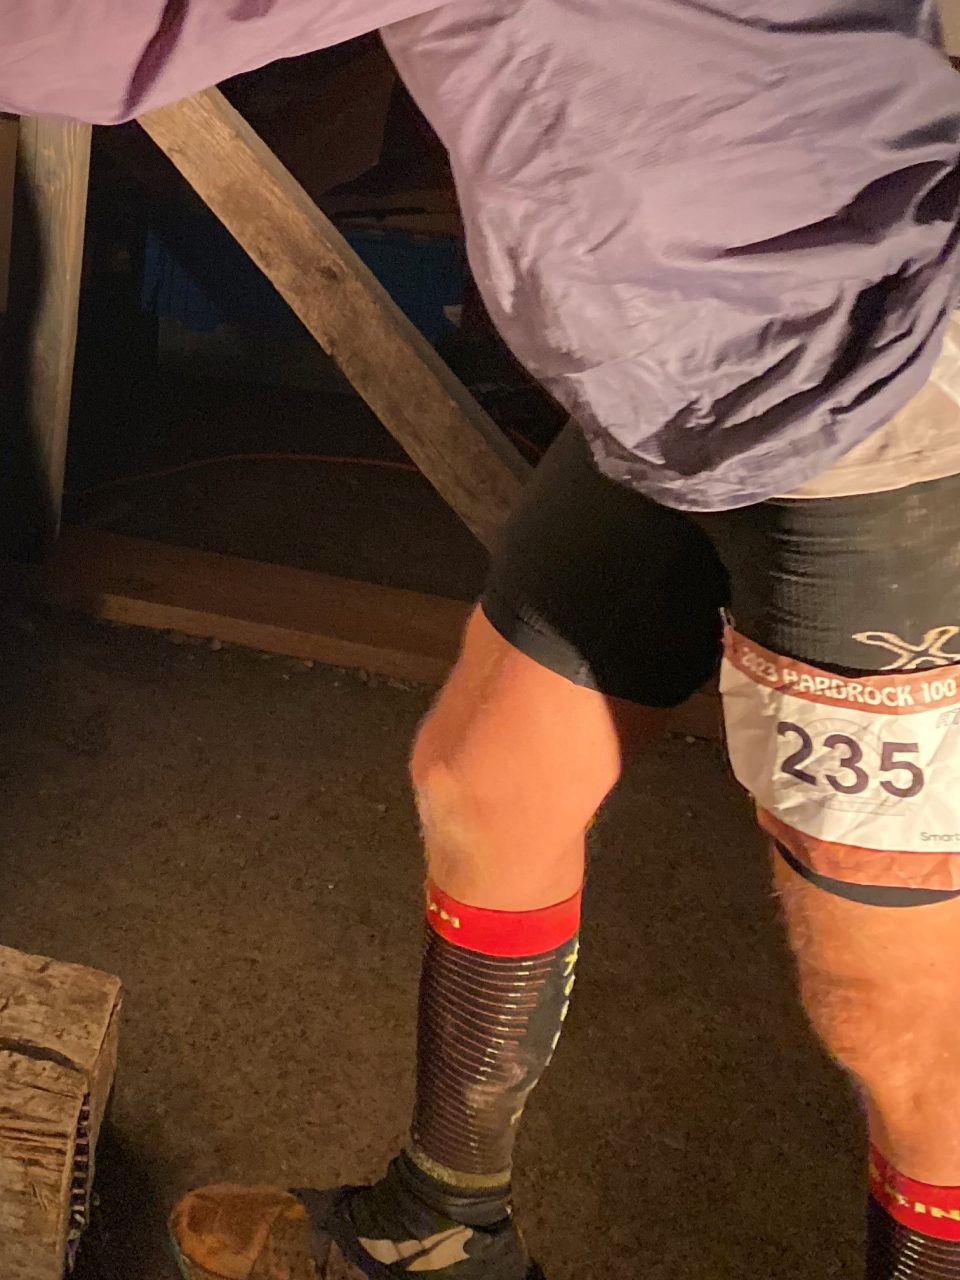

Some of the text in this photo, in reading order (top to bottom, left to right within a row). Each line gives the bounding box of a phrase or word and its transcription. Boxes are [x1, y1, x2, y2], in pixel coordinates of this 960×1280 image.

[782, 668, 915, 707] HARDROCK
[920, 677, 958, 704] 100
[776, 720, 925, 799] 235
